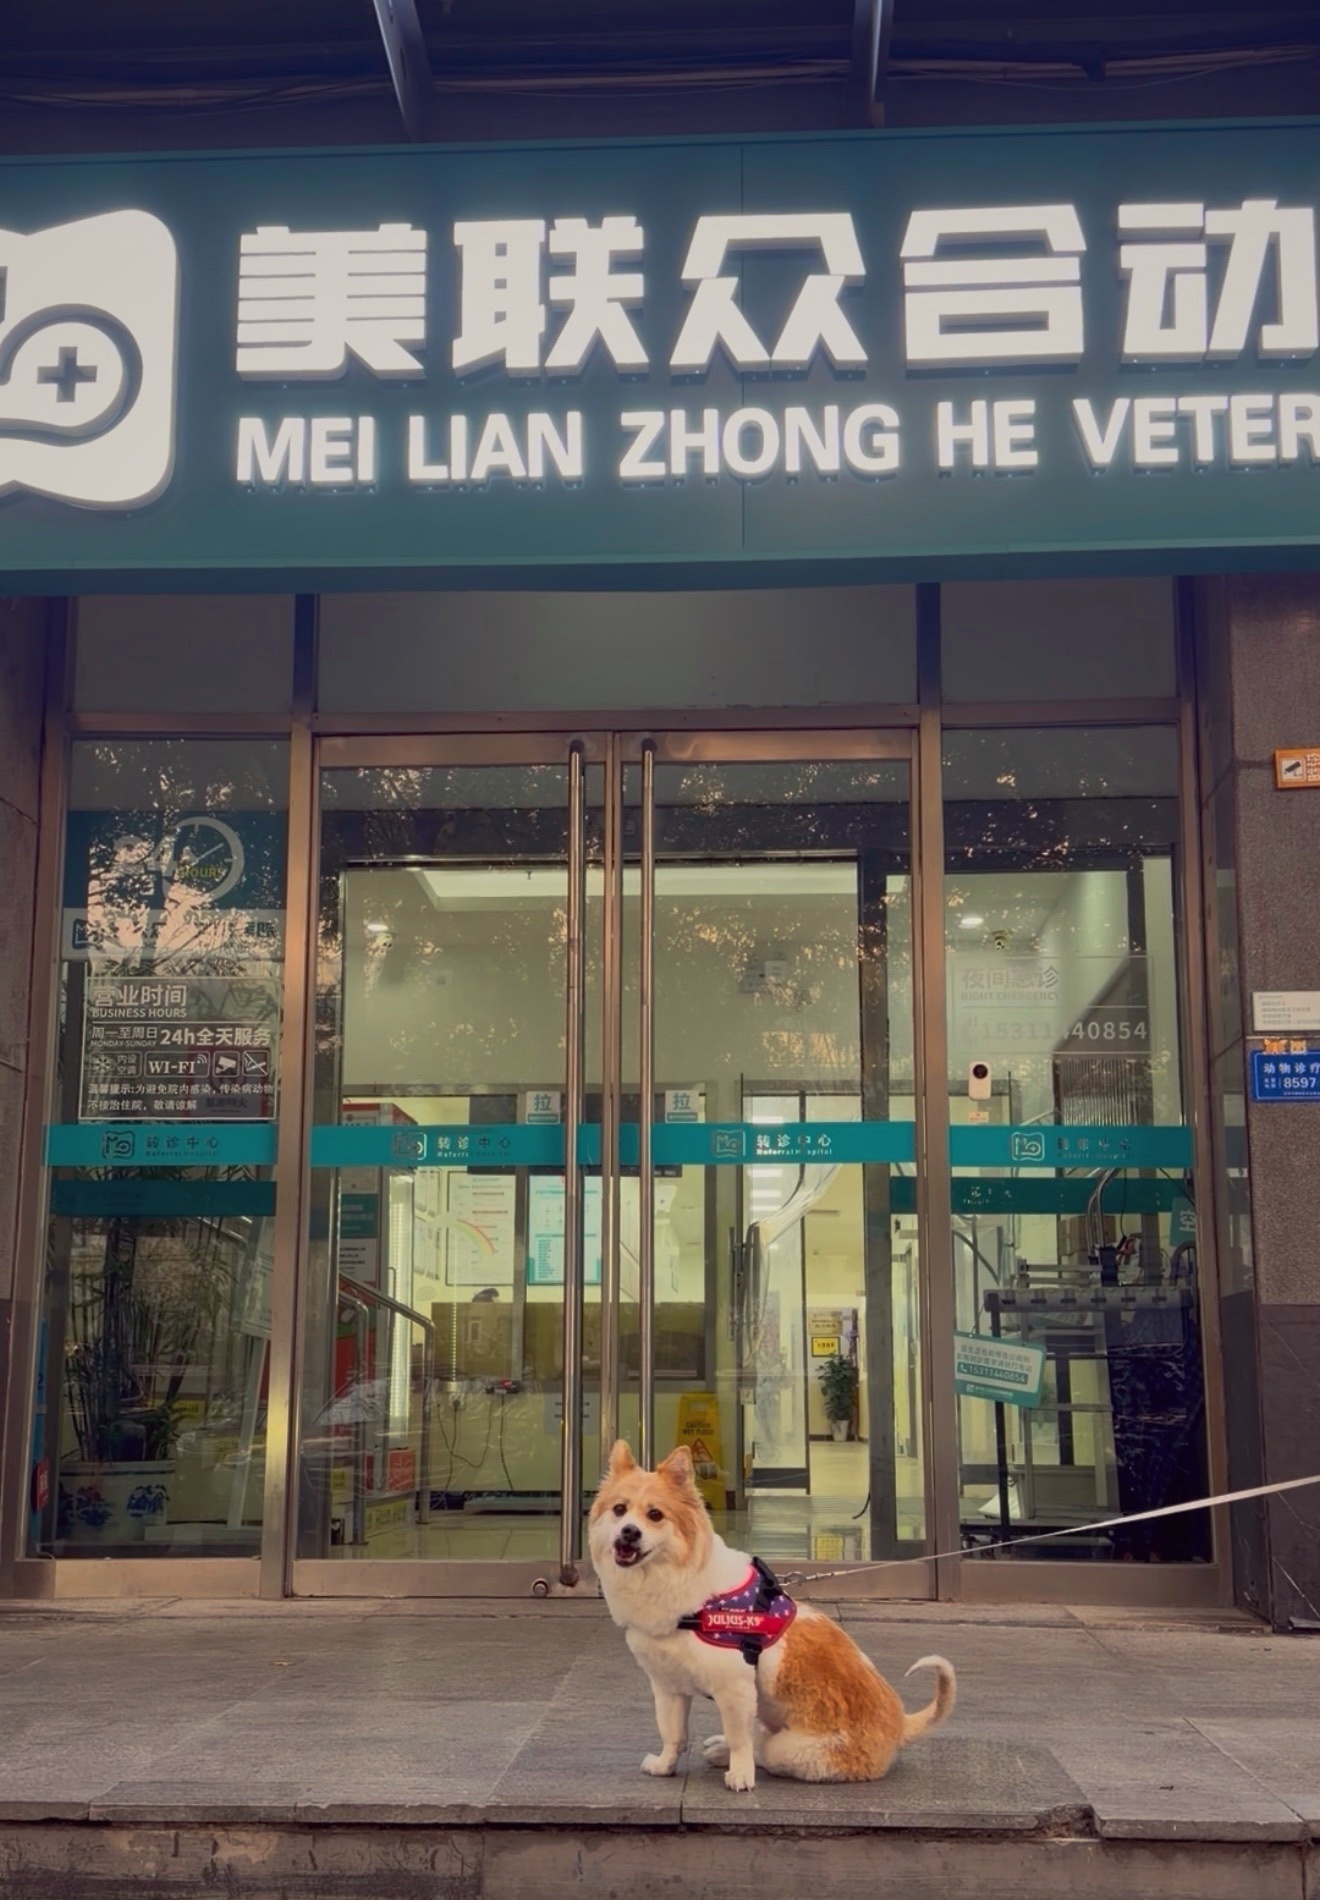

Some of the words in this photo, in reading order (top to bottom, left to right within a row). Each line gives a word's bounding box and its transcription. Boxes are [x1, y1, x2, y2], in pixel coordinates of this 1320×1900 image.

[236, 200, 1319, 374] 美联众合动
[236, 416, 375, 482] MEI
[408, 411, 582, 479] LIAN
[619, 403, 900, 478] ZHONG
[937, 399, 1038, 467] HE
[962, 966, 1059, 989] 夜间急诊
[93, 984, 187, 1007] 营业时间
[92, 1008, 146, 1018] BUSINESS
[149, 1008, 187, 1018] HOURS
[91, 1026, 157, 1039] 周一至周日
[160, 1027, 271, 1046] 24h全天服务
[982, 1022, 1147, 1041] 1531140854
[148, 1060, 196, 1074] WI-FI
[534, 1093, 551, 1112] 拉
[673, 1092, 691, 1110] 拉
